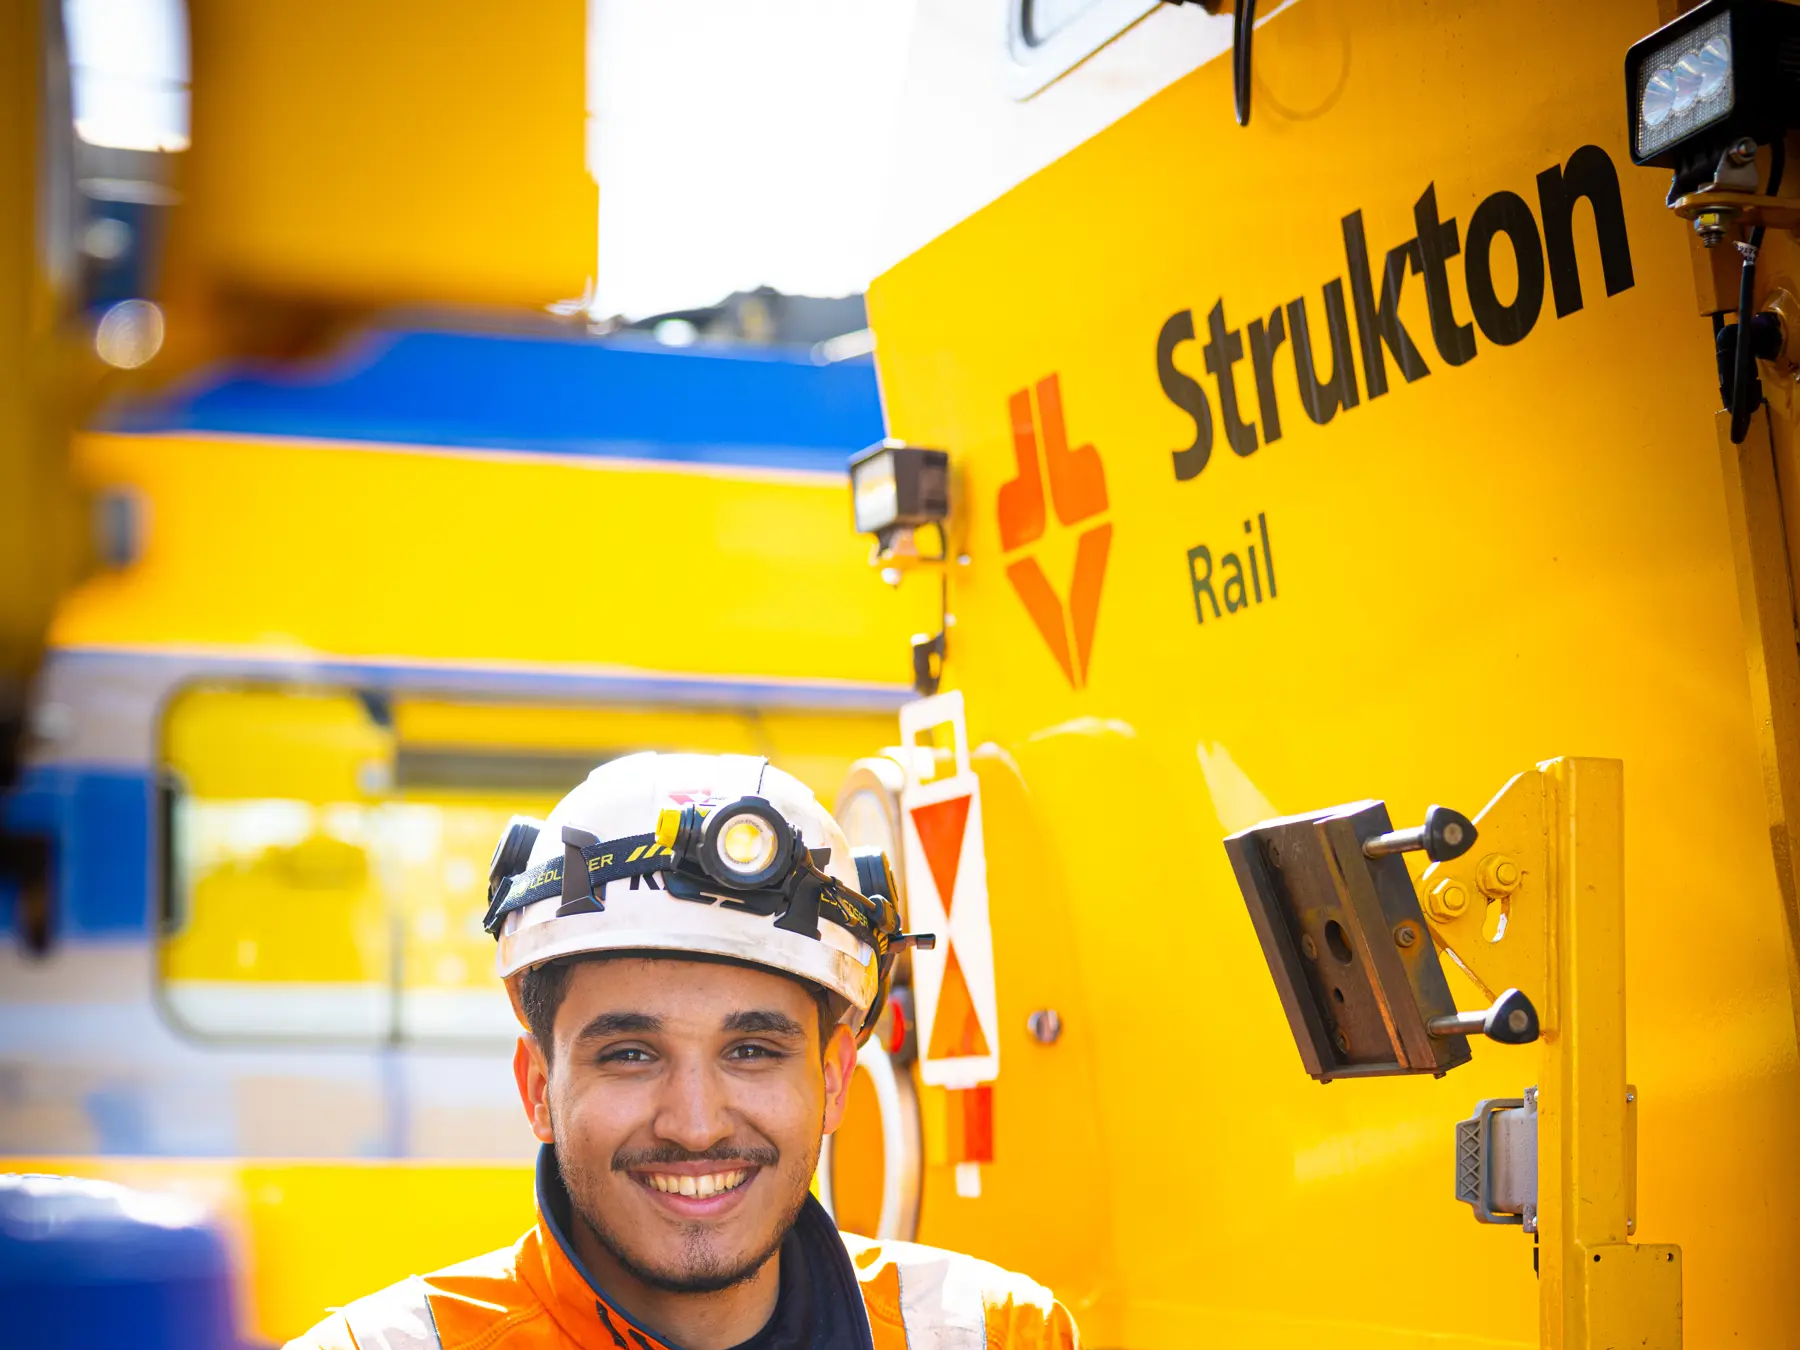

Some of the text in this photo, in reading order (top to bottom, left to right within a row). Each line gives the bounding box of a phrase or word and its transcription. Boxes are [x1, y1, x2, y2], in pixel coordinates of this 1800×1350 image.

[1156, 144, 1635, 482] Strukton
[1187, 511, 1278, 625] Rail
[529, 853, 614, 889] LEDLER
